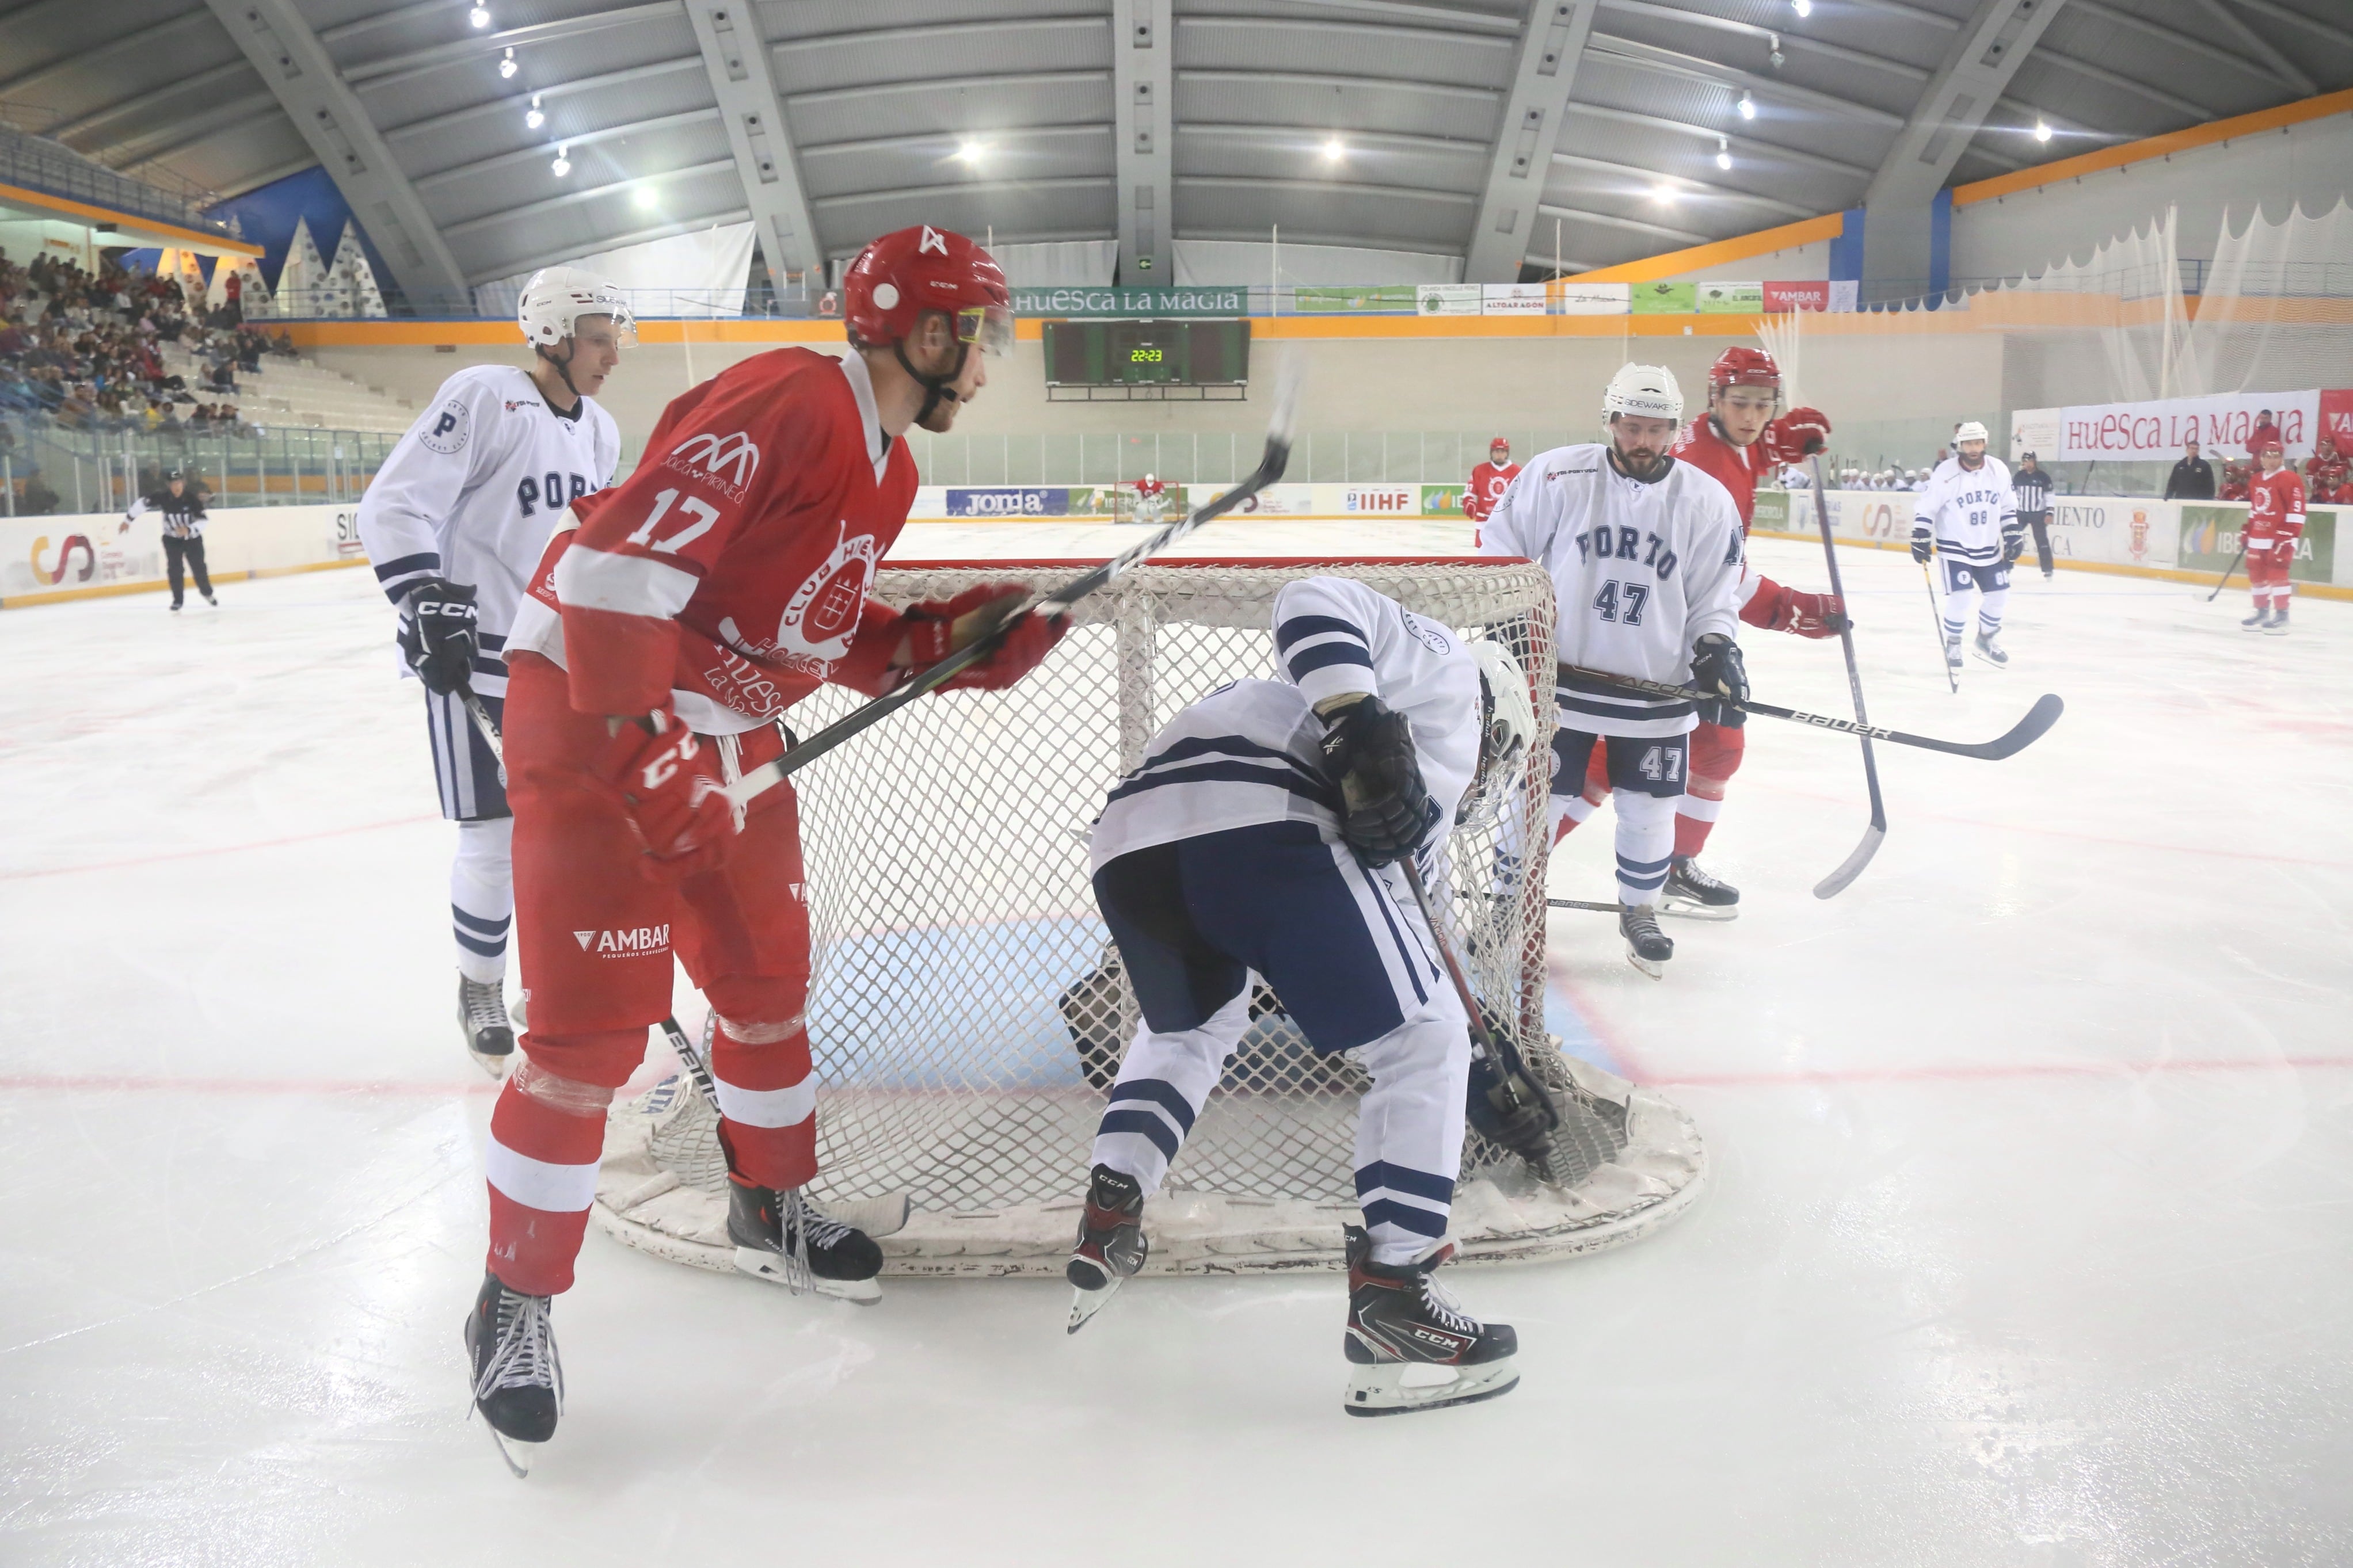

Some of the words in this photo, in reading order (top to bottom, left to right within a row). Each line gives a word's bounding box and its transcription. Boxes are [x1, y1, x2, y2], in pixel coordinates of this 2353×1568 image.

[1779, 291, 1821, 302] AMBAR
[1131, 349, 1163, 362] 22:23
[433, 411, 456, 438] P
[2207, 409, 2303, 445] Maia
[1361, 493, 1408, 510] IIHF
[2293, 500, 2302, 513] 9
[626, 487, 721, 555] 17
[1970, 511, 1988, 525] 88
[2051, 506, 2105, 528] IENTO
[1575, 525, 1678, 581] PORTO
[784, 563, 831, 626] CLUB
[1593, 579, 1650, 627] 47
[1639, 746, 1682, 781] 47
[597, 924, 670, 952] AMBAR
[668, 1032, 719, 1111] BAUE
[1099, 1174, 1129, 1189] CCM
[1127, 1256, 1139, 1266] CCM
[1414, 1329, 1459, 1349] CCM
